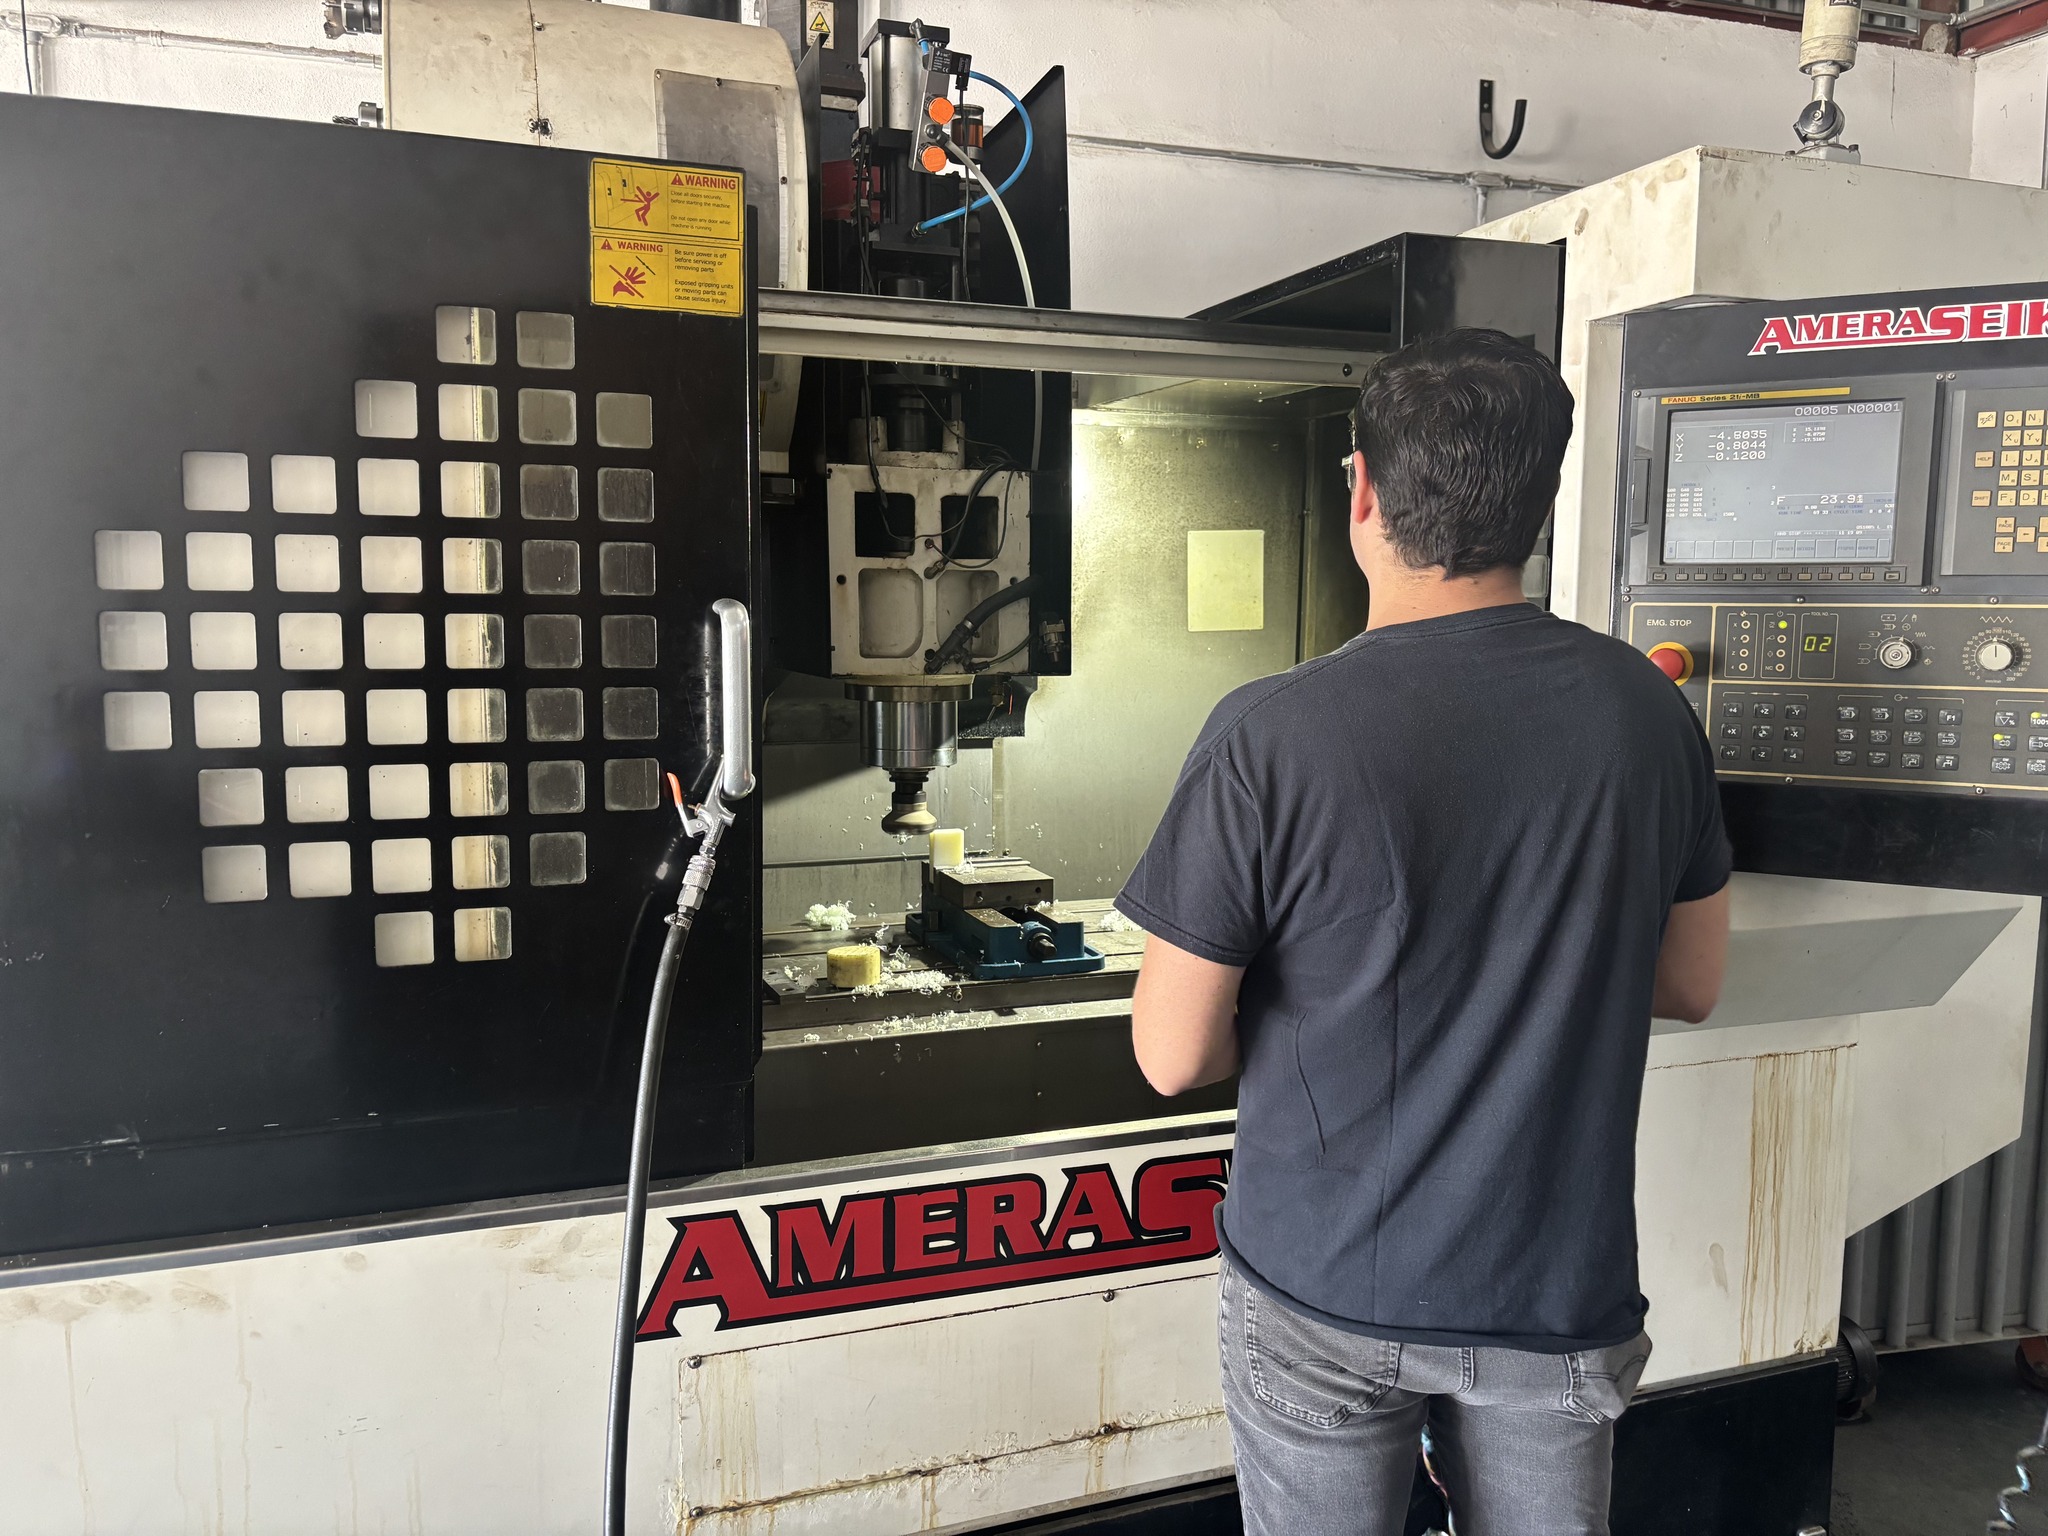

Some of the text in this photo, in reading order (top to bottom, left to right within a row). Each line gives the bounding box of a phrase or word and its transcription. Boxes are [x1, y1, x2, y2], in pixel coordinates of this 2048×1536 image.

[685, 174, 737, 190] WARNING
[617, 241, 663, 253] WARNING
[693, 259, 717, 267] servicing
[674, 279, 697, 287] Exposed
[698, 281, 720, 290] gripping
[711, 297, 727, 305] injury
[1667, 395, 1697, 404] FANUC
[1699, 393, 1727, 403] Series
[1847, 401, 1901, 415] N00001
[2006, 413, 2015, 423] O
[2028, 413, 2037, 422] N
[1676, 428, 1768, 442] X -4.8035
[2005, 433, 2013, 442] X
[2026, 432, 2034, 441] Y
[1675, 439, 1767, 452] Y -0.8044
[1674, 450, 1766, 463] Z -0.1200
[2025, 453, 2033, 462] J
[2001, 473, 2010, 482] M
[2023, 473, 2031, 482] S
[1776, 496, 1786, 506] F
[2000, 493, 2008, 501] F
[2022, 492, 2030, 501] D
[1646, 619, 1692, 627] EMG. STOP
[1803, 636, 1833, 652] 02
[1946, 714, 1957, 722] F1
